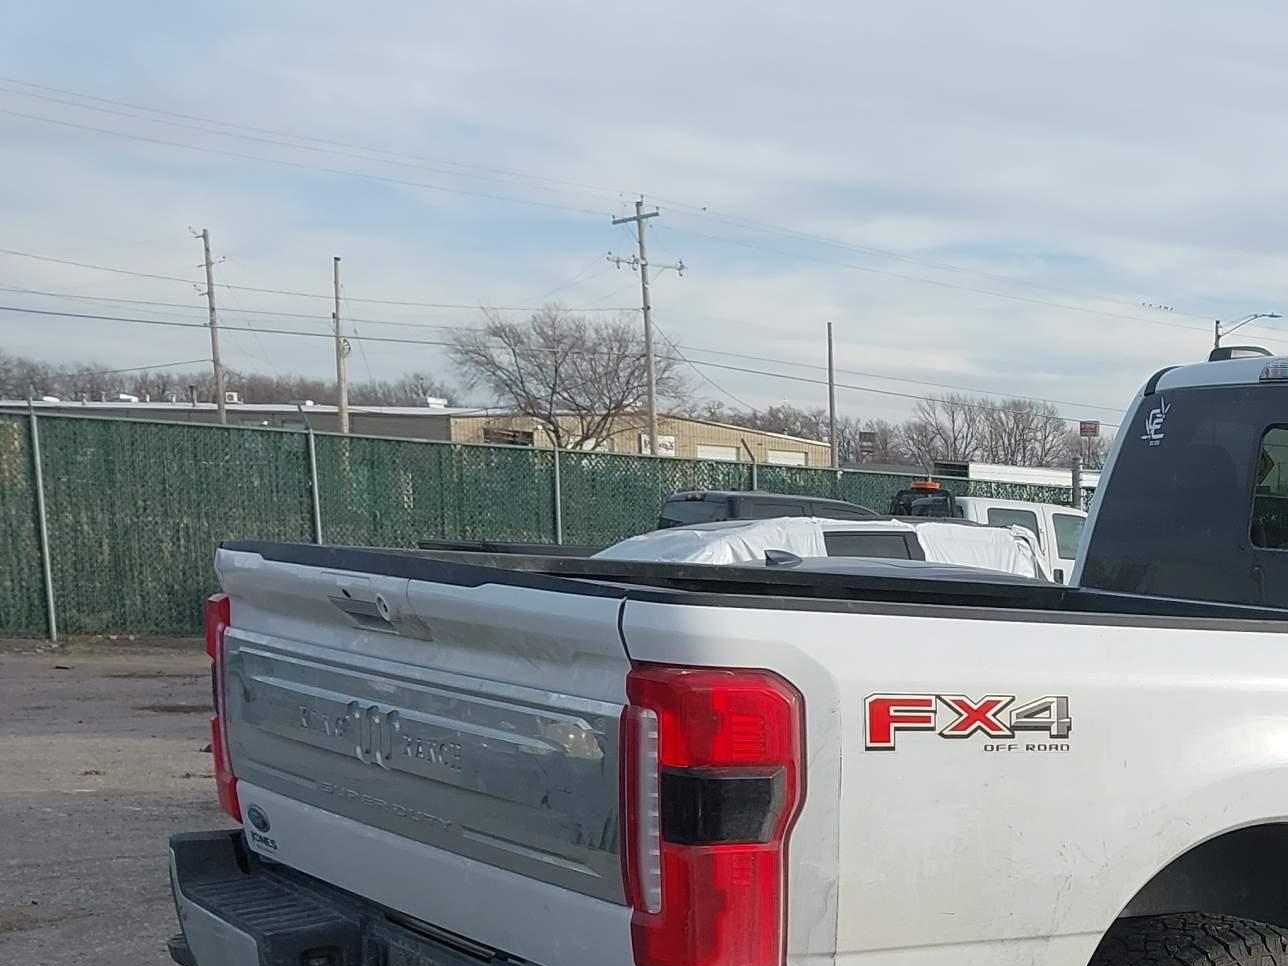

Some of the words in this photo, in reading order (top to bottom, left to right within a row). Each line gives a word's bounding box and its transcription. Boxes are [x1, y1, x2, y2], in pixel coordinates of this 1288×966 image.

[864, 693, 1072, 751] FX4
[983, 743, 1020, 752] OFF
[1026, 743, 1070, 752] ROAD
